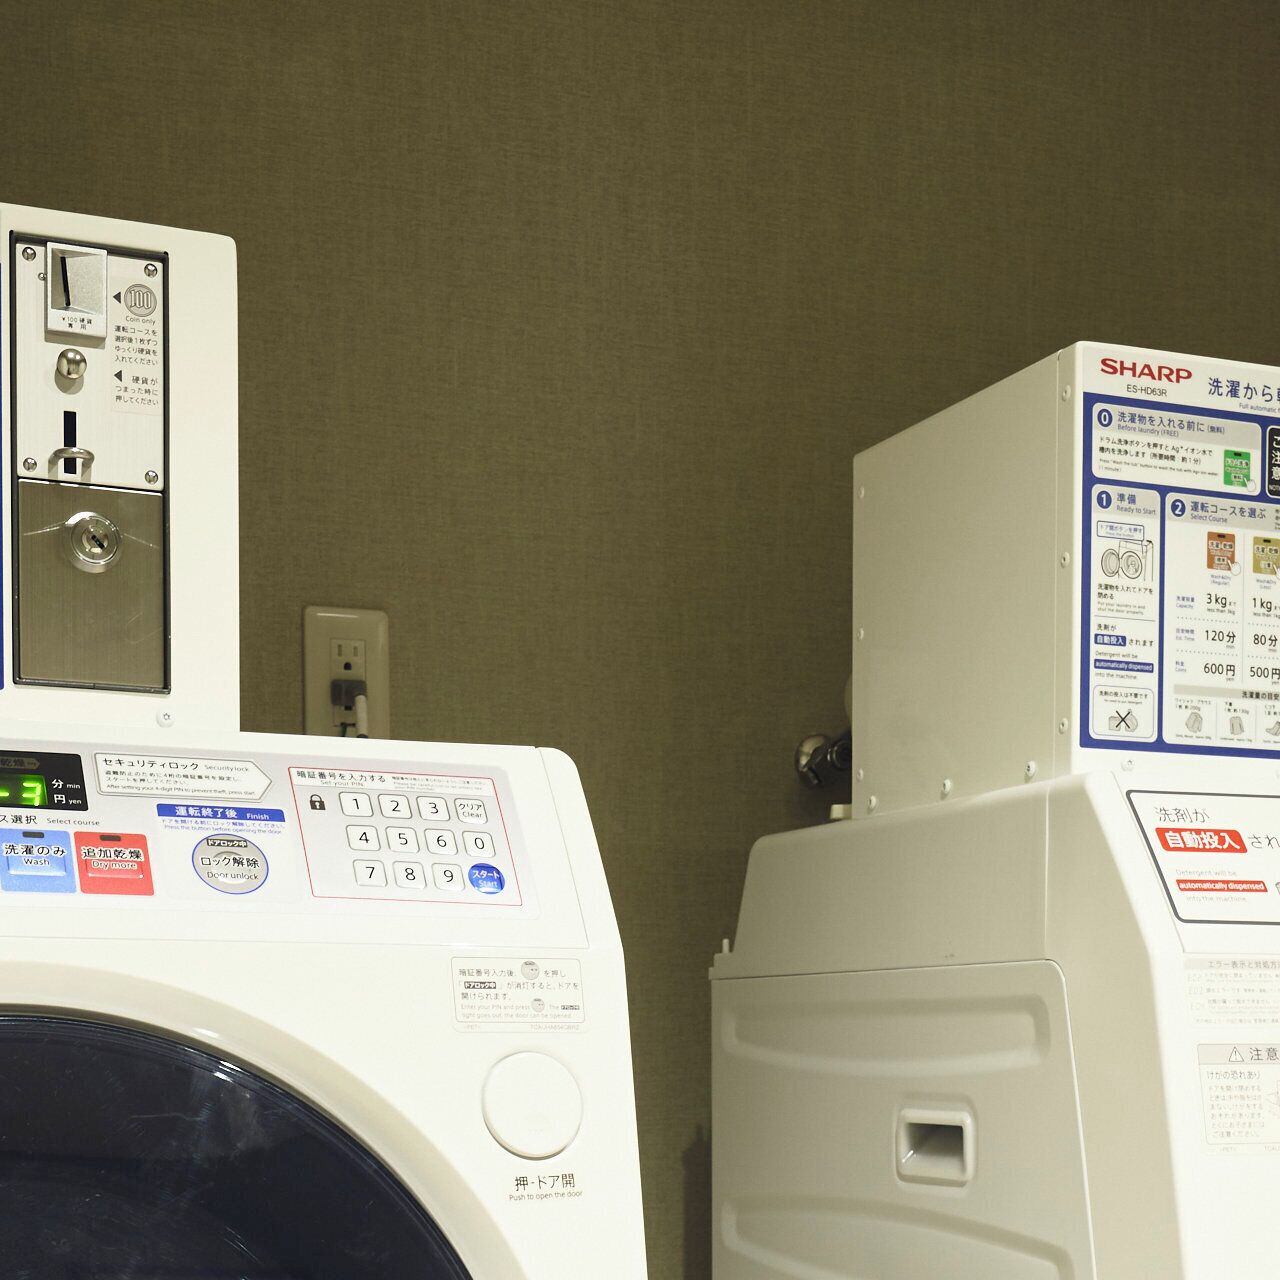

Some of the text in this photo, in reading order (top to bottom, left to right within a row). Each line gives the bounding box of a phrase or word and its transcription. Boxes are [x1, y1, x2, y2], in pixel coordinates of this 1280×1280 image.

[1101, 358, 1192, 383] SHARP
[1126, 384, 1167, 397] ES-HD63R
[1118, 411, 1205, 432] 洗濯物を入れる前に
[1117, 493, 1136, 505] 準備
[1191, 501, 1266, 519] 運転コースを選ぶ
[102, 757, 199, 772] セキュリティロック
[296, 769, 386, 783] 暗証番号を入力する
[175, 806, 237, 819] 運転終了後
[353, 798, 439, 814] 1 2 3
[459, 802, 481, 812] クリア
[247, 812, 269, 821] Finish
[462, 810, 482, 818] Clear
[359, 832, 484, 850] 4 5 6 0
[1165, 830, 1240, 849] 自動投入
[4, 844, 66, 857] 洗濯のみ
[81, 847, 143, 862] 追加乾燥
[23, 857, 50, 867] Wash
[92, 860, 136, 870] Dry more
[201, 855, 259, 869] ロック解除
[366, 867, 453, 882] 7 8 9
[471, 869, 500, 880] スタート
[478, 879, 497, 888] Start
[1179, 881, 1264, 892] automatically dispensed
[1250, 1047, 1279, 1061] 注意
